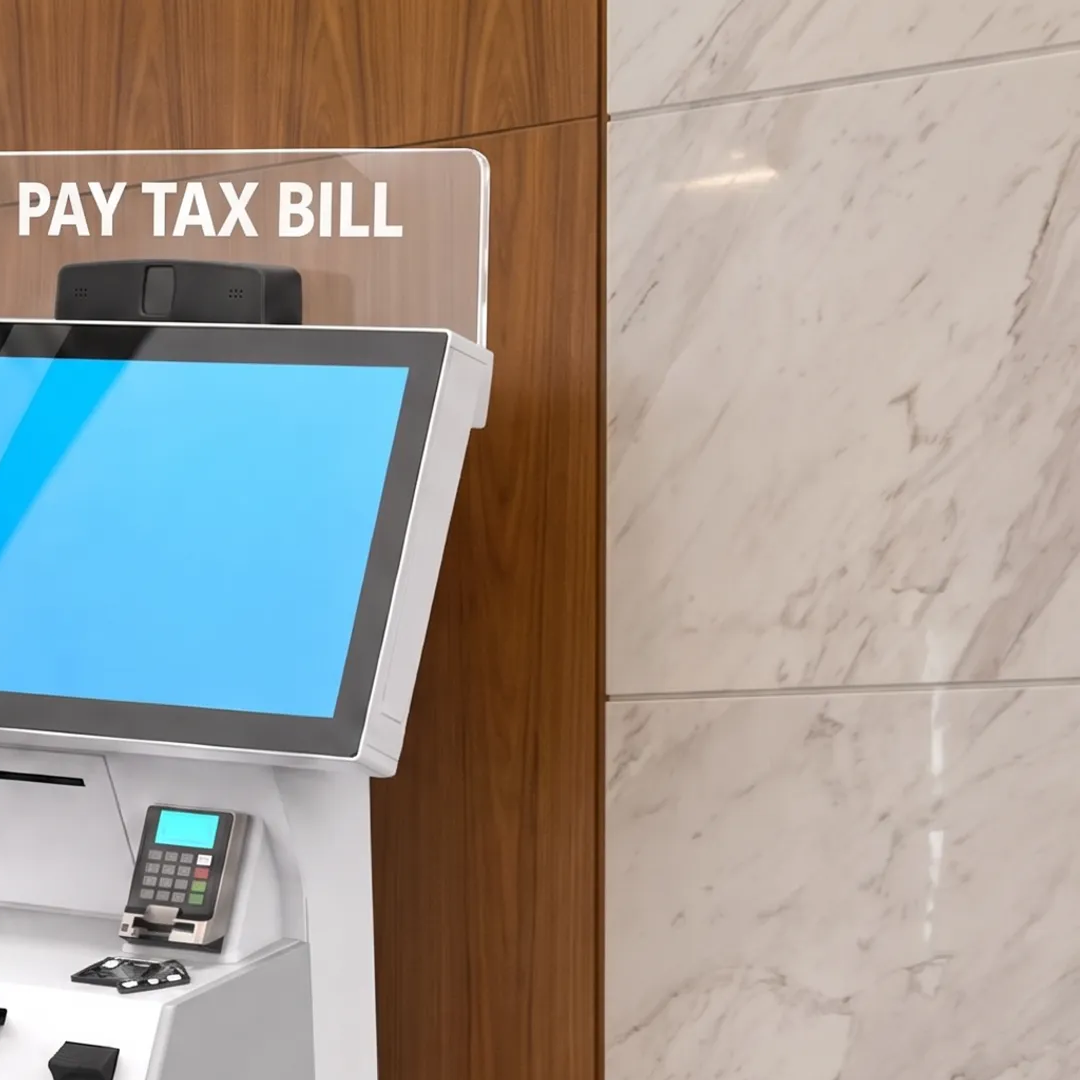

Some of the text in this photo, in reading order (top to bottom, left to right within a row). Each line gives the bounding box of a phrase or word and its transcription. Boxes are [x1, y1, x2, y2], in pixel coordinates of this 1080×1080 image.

[17, 181, 404, 239] PAY TAX BILL
